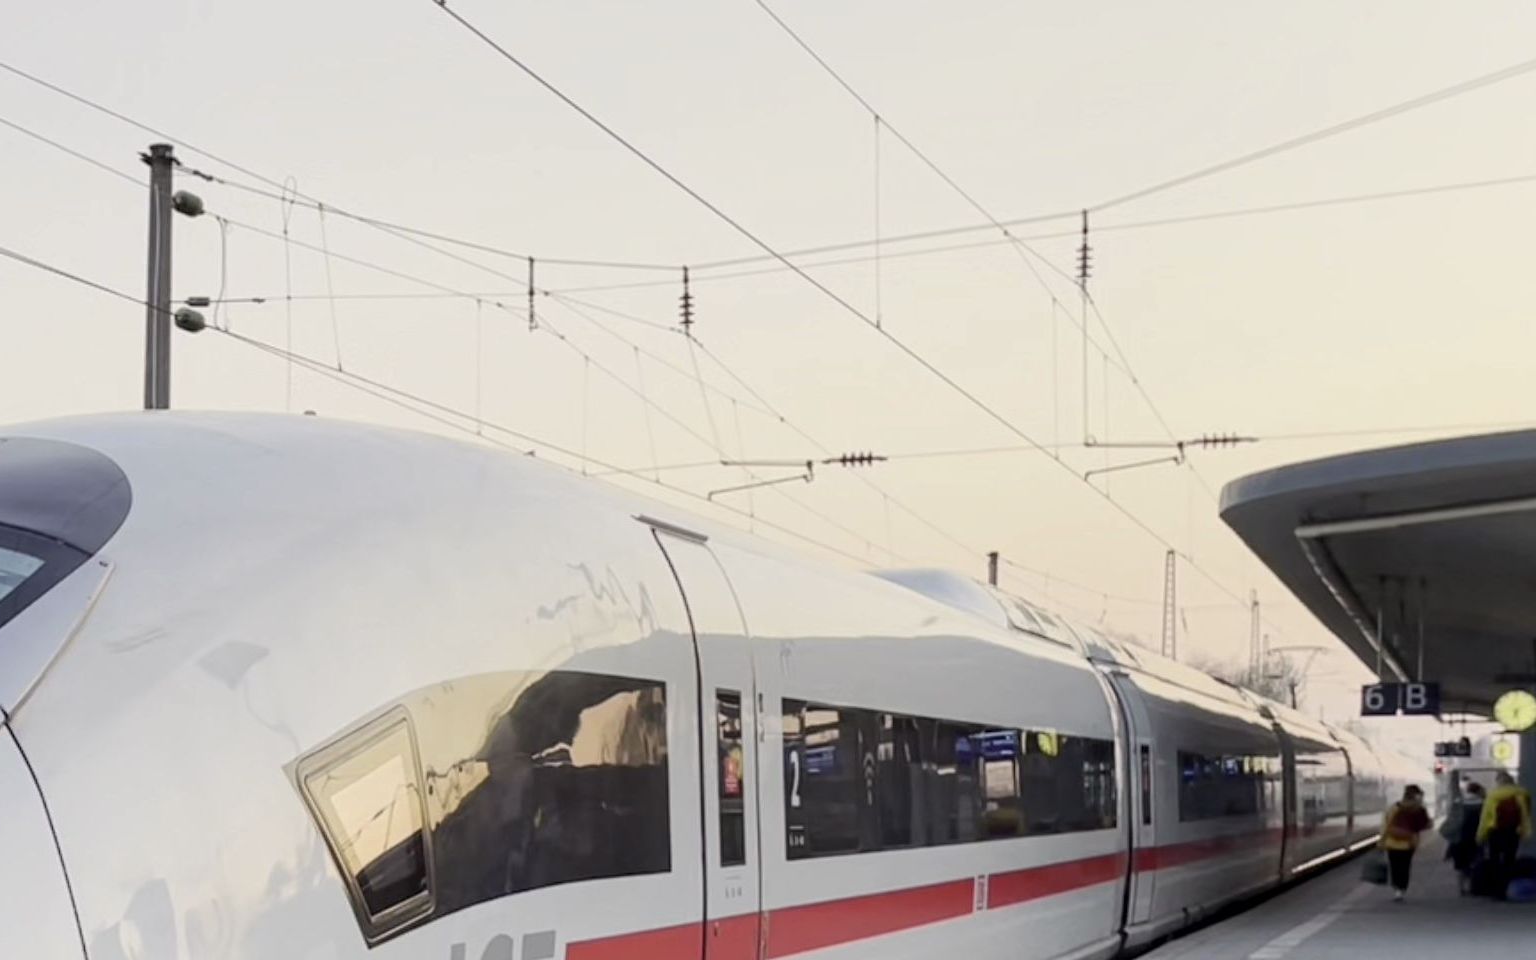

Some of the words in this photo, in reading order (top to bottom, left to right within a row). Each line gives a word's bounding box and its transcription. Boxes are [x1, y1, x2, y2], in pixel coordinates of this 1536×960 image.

[1365, 685, 1384, 710] 6
[1405, 683, 1427, 709] B
[790, 750, 801, 807] 2
